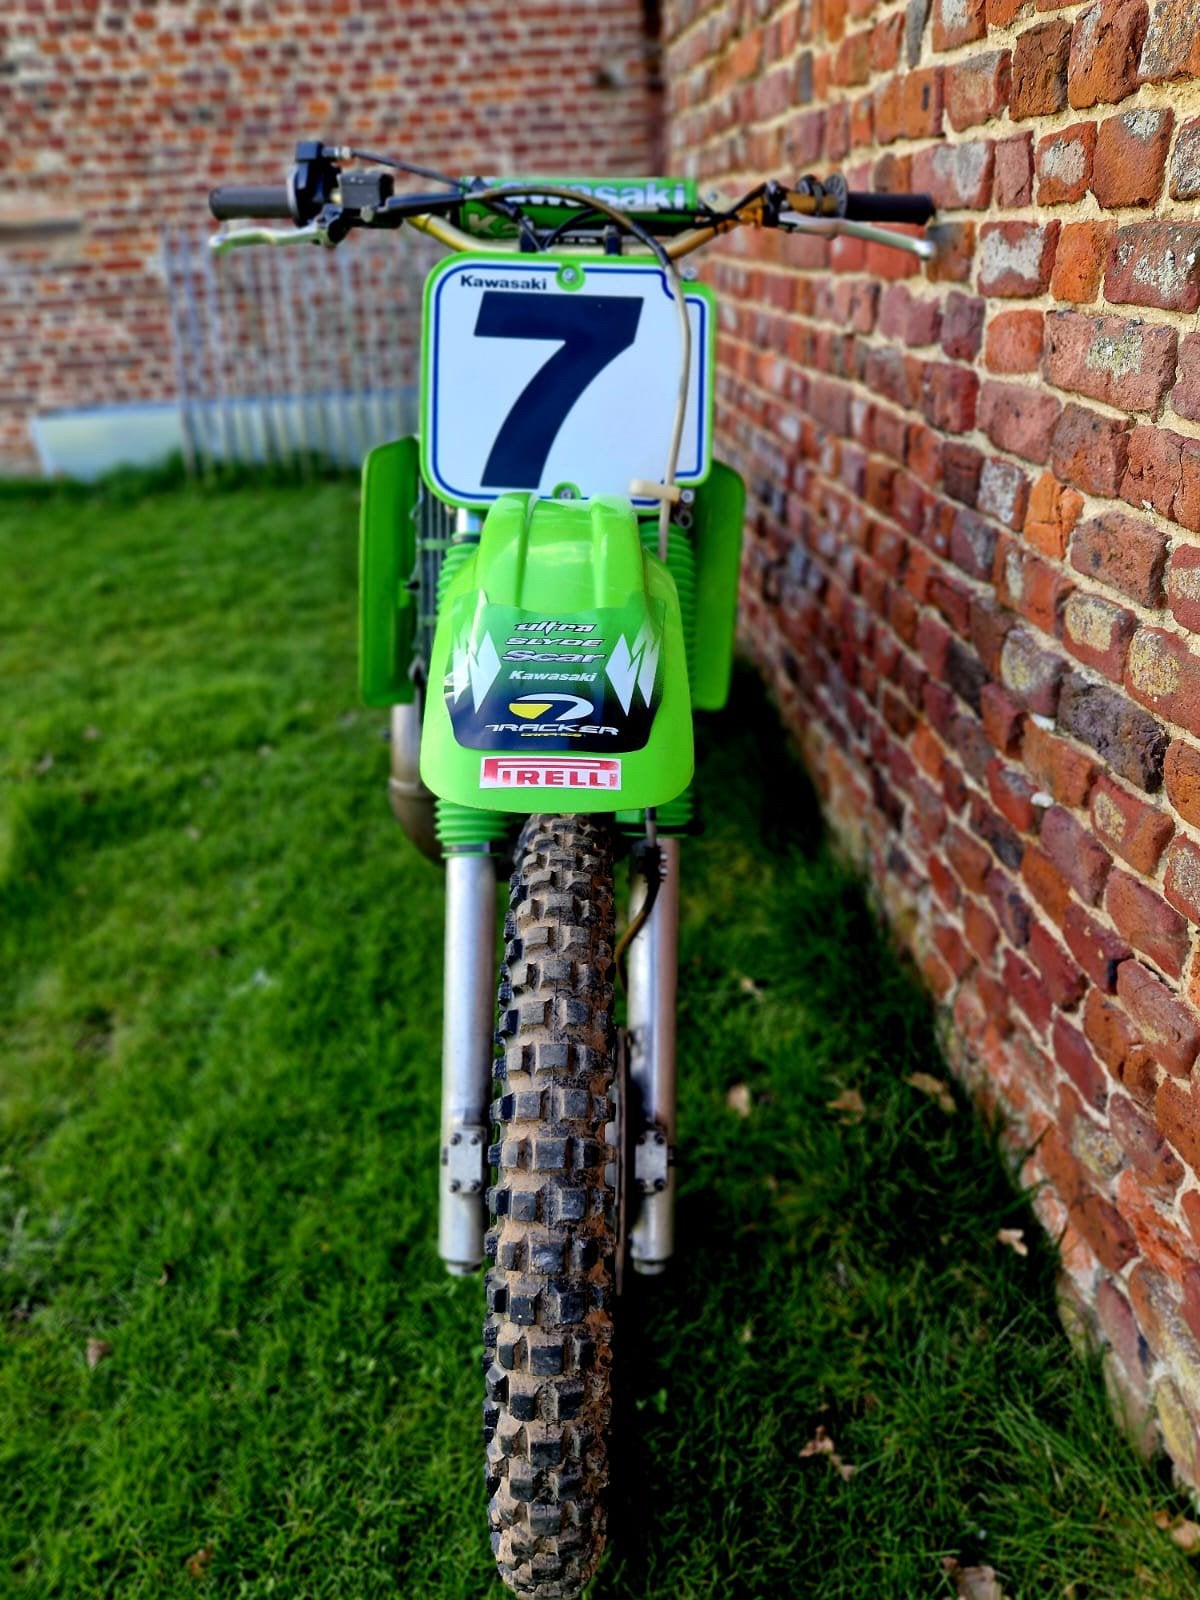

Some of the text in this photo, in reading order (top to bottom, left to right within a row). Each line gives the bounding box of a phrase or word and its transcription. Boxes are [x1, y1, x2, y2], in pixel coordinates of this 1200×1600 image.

[466, 176, 687, 210] asaki
[460, 274, 548, 291] Kawasaki
[474, 291, 644, 489] 7
[515, 621, 597, 635] ultra
[505, 637, 605, 647] SLYDE
[501, 649, 606, 663] Scar
[509, 670, 598, 682] Kawasaki
[485, 724, 619, 735] TRACKER
[484, 757, 618, 787] PIRELLI
